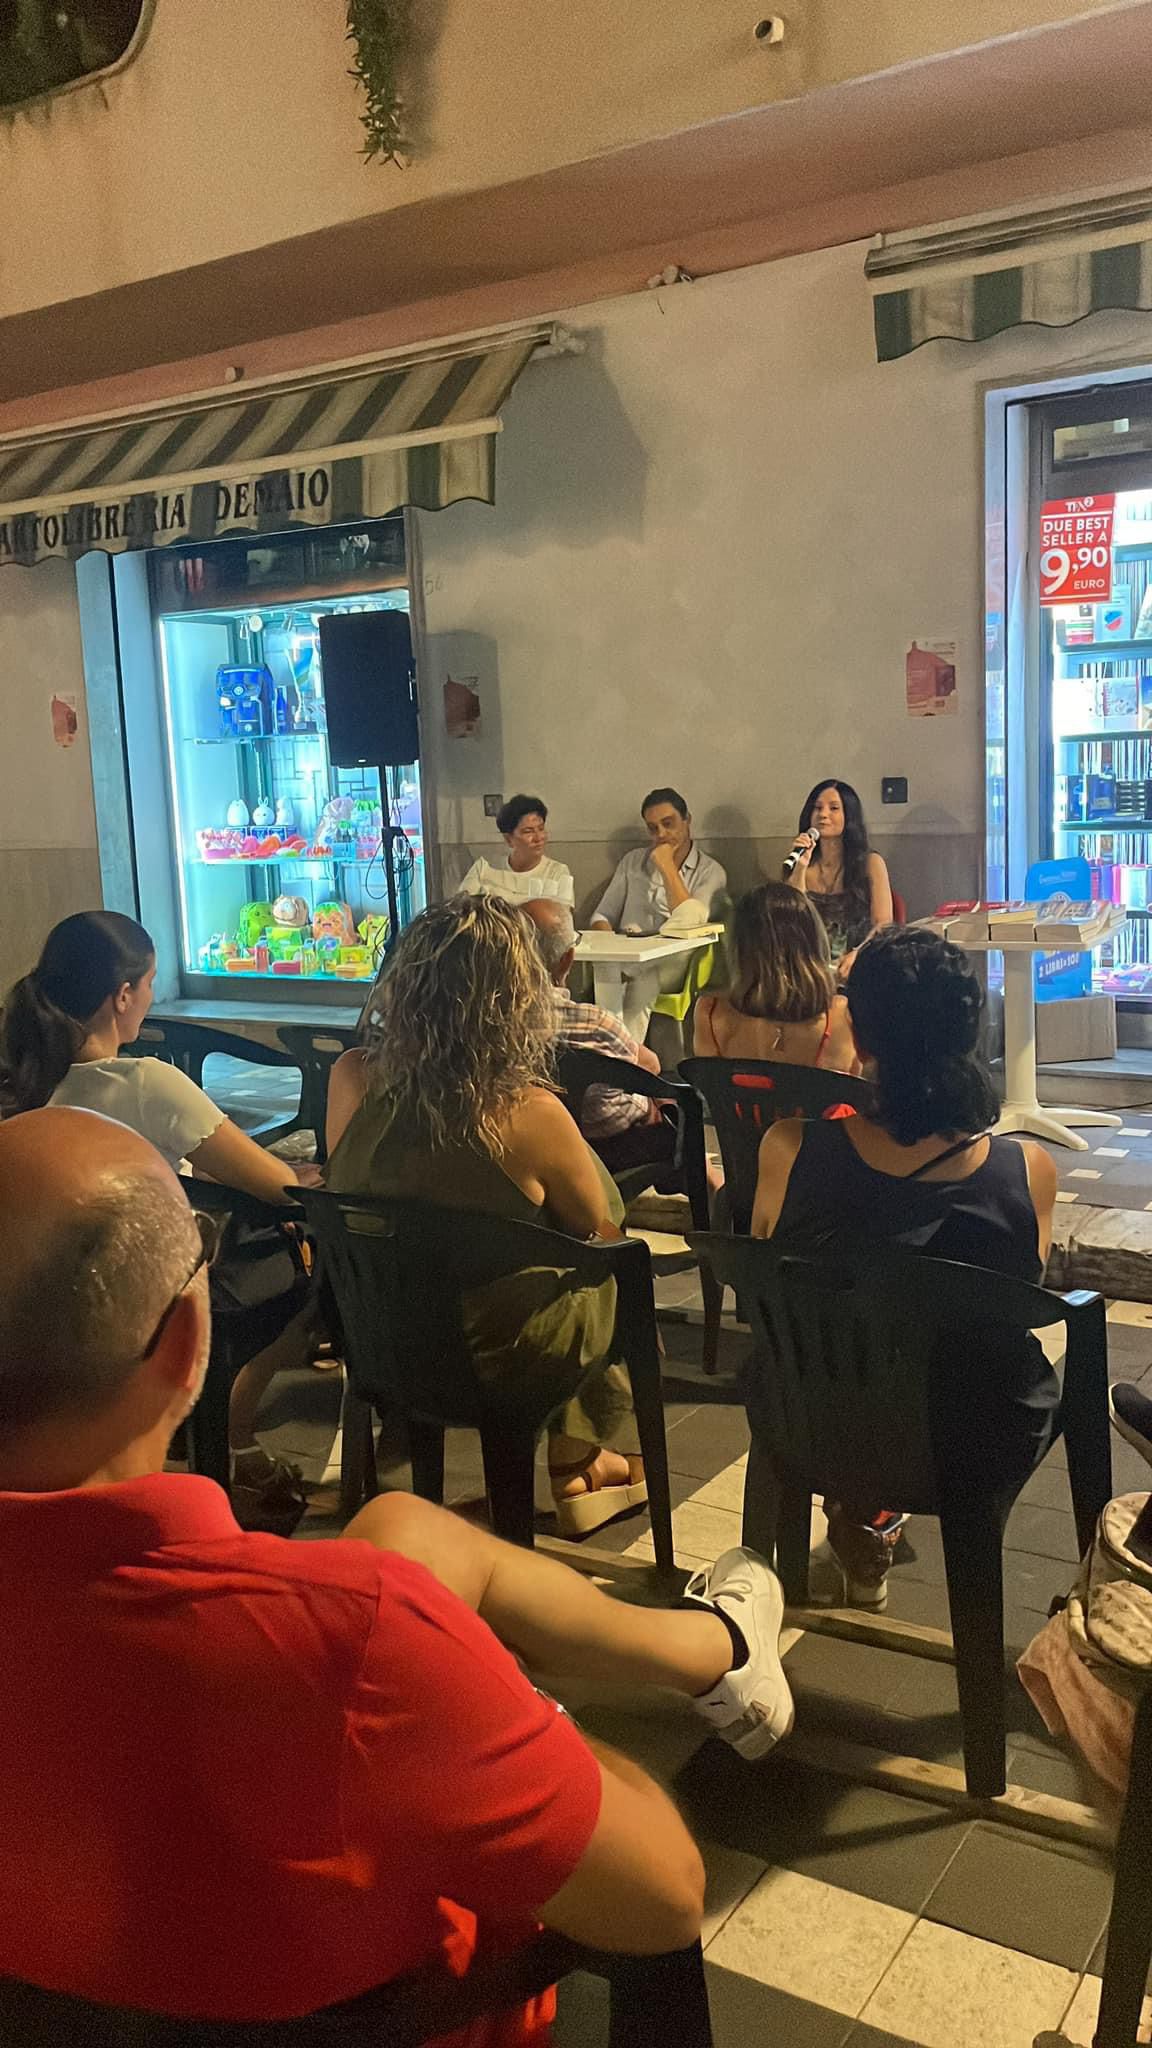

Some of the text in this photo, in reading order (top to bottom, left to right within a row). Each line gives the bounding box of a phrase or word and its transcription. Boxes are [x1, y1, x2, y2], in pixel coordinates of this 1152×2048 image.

[1043, 516, 1110, 533] DUE BEST
[1042, 530, 1108, 547] SELLER A
[1040, 546, 1108, 595] 9,90
[1073, 579, 1105, 590] EURO
